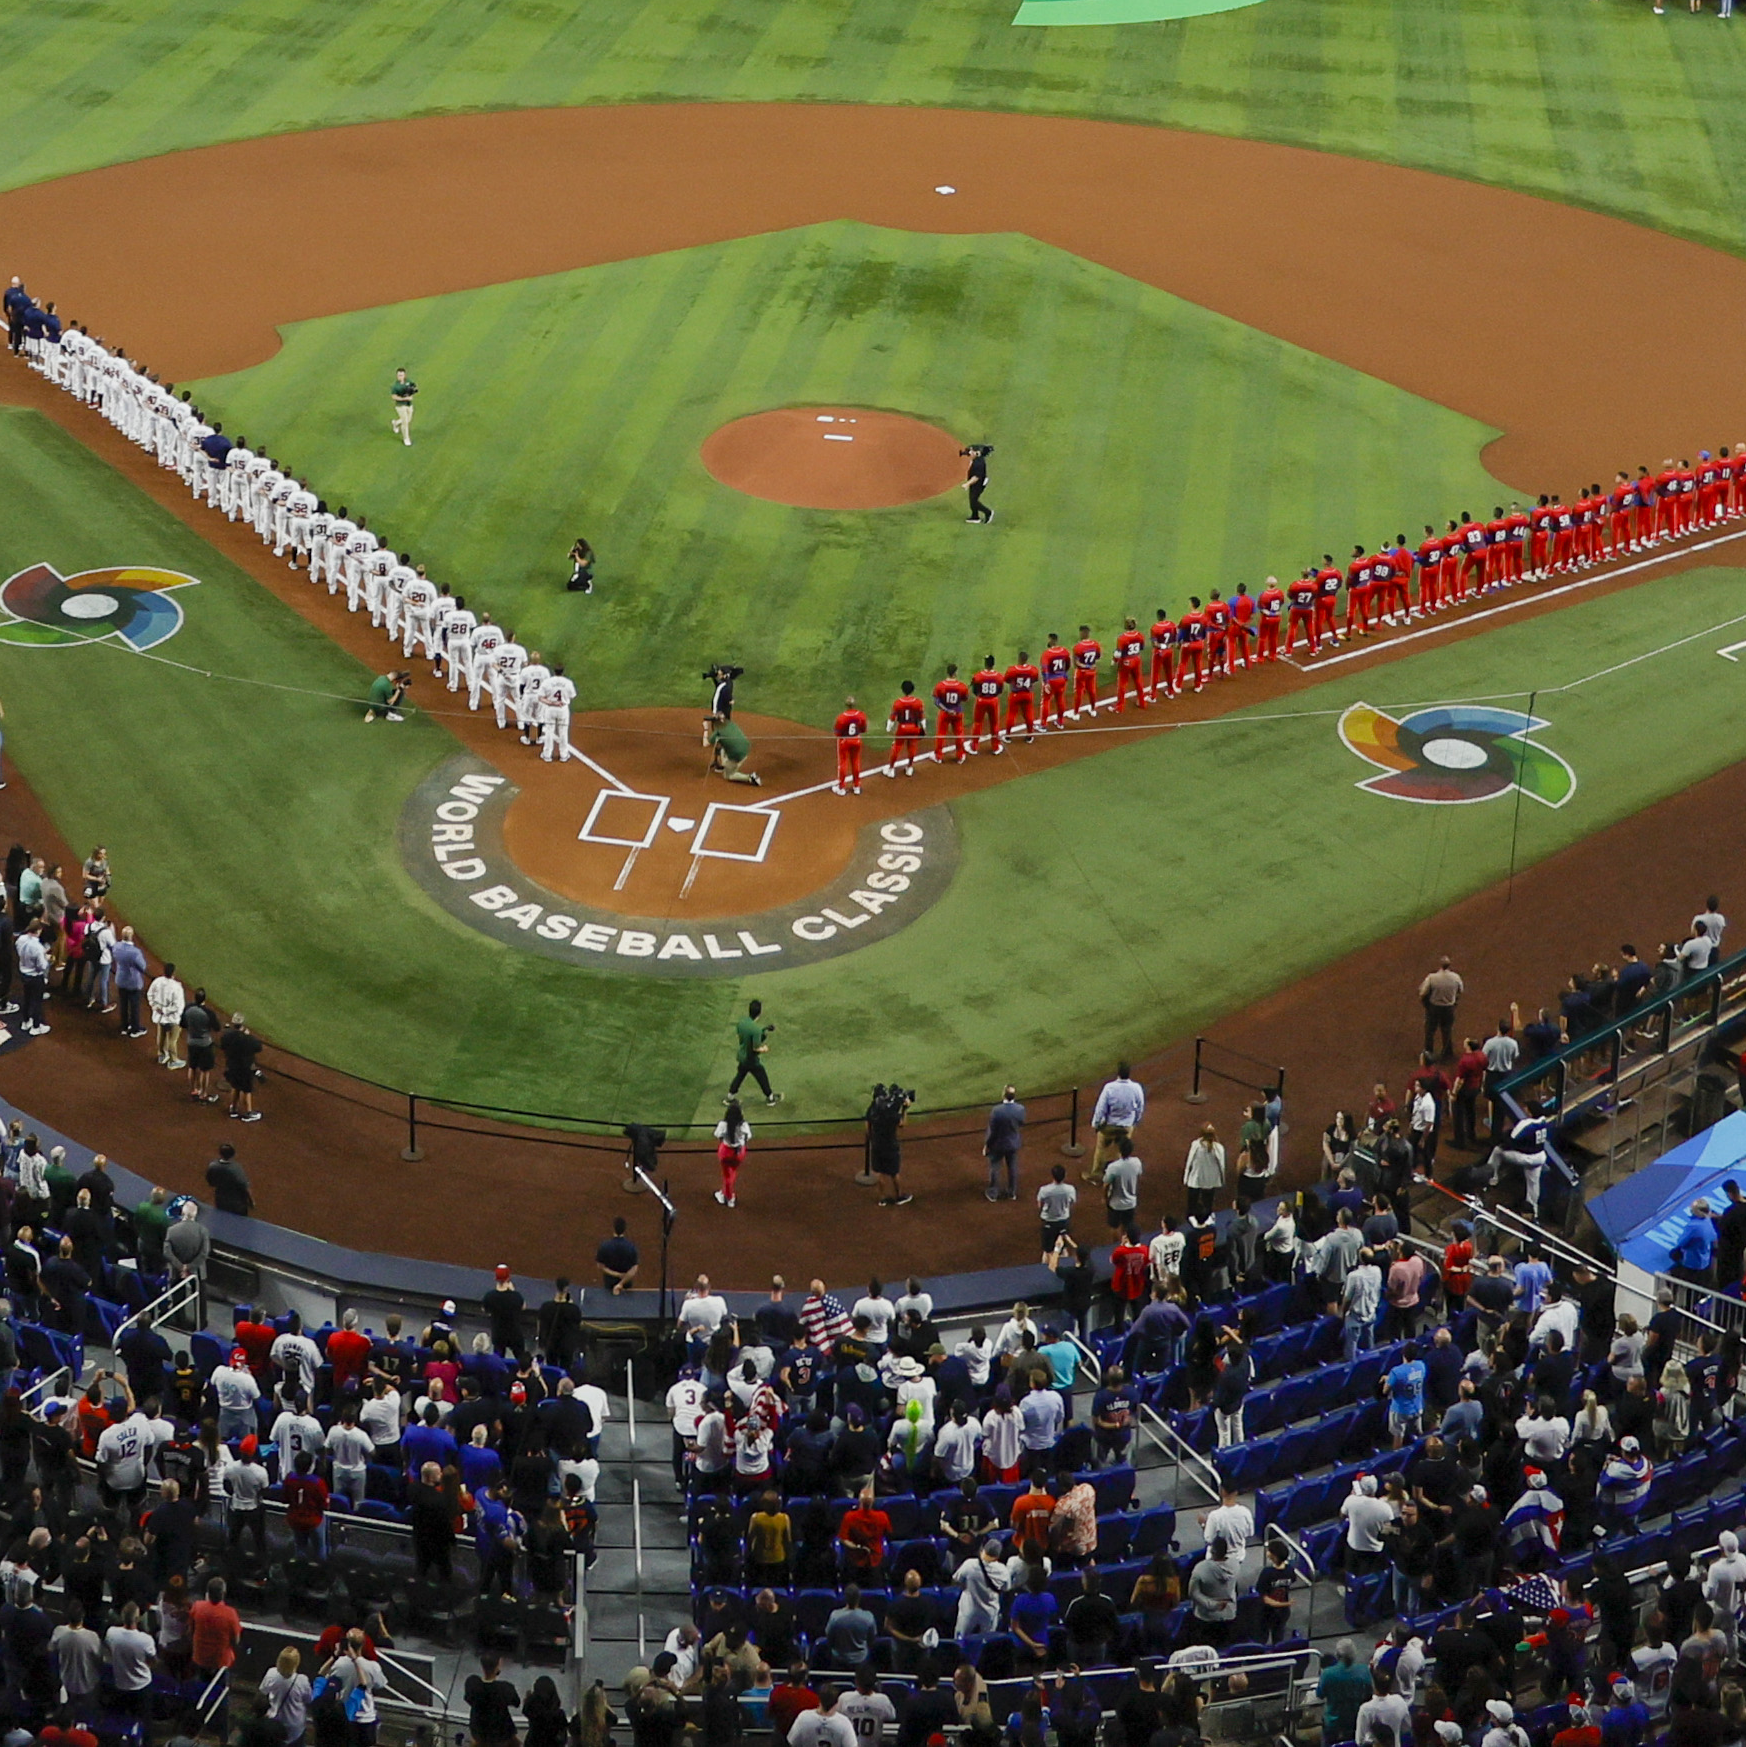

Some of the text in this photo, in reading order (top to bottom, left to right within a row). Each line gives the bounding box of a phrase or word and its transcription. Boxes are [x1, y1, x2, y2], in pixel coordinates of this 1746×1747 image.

[316, 524, 327, 535] 31
[355, 542, 366, 553] 21
[1325, 578, 1338, 591] 22
[412, 592, 426, 603] 20
[1298, 592, 1312, 603] 27
[451, 623, 467, 634] 28
[1190, 623, 1201, 635] 17
[481, 638, 497, 649] 46
[1163, 632, 1171, 643] 7
[1128, 643, 1140, 655] 33
[500, 657, 516, 668] 27
[1084, 651, 1096, 663] 77
[532, 679, 540, 690] 3
[1016, 677, 1031, 688] 54
[553, 690, 562, 702] 4
[946, 692, 958, 704] 10
[848, 723, 856, 735] 6
[432, 774, 923, 960] WORLD BASEBALL CLASSIC
[383, 1356, 400, 1372] 17
[685, 1389, 696, 1405] 3
[290, 1434, 302, 1451] 3
[121, 1440, 137, 1458] 12
[853, 1718, 874, 1736] 10
